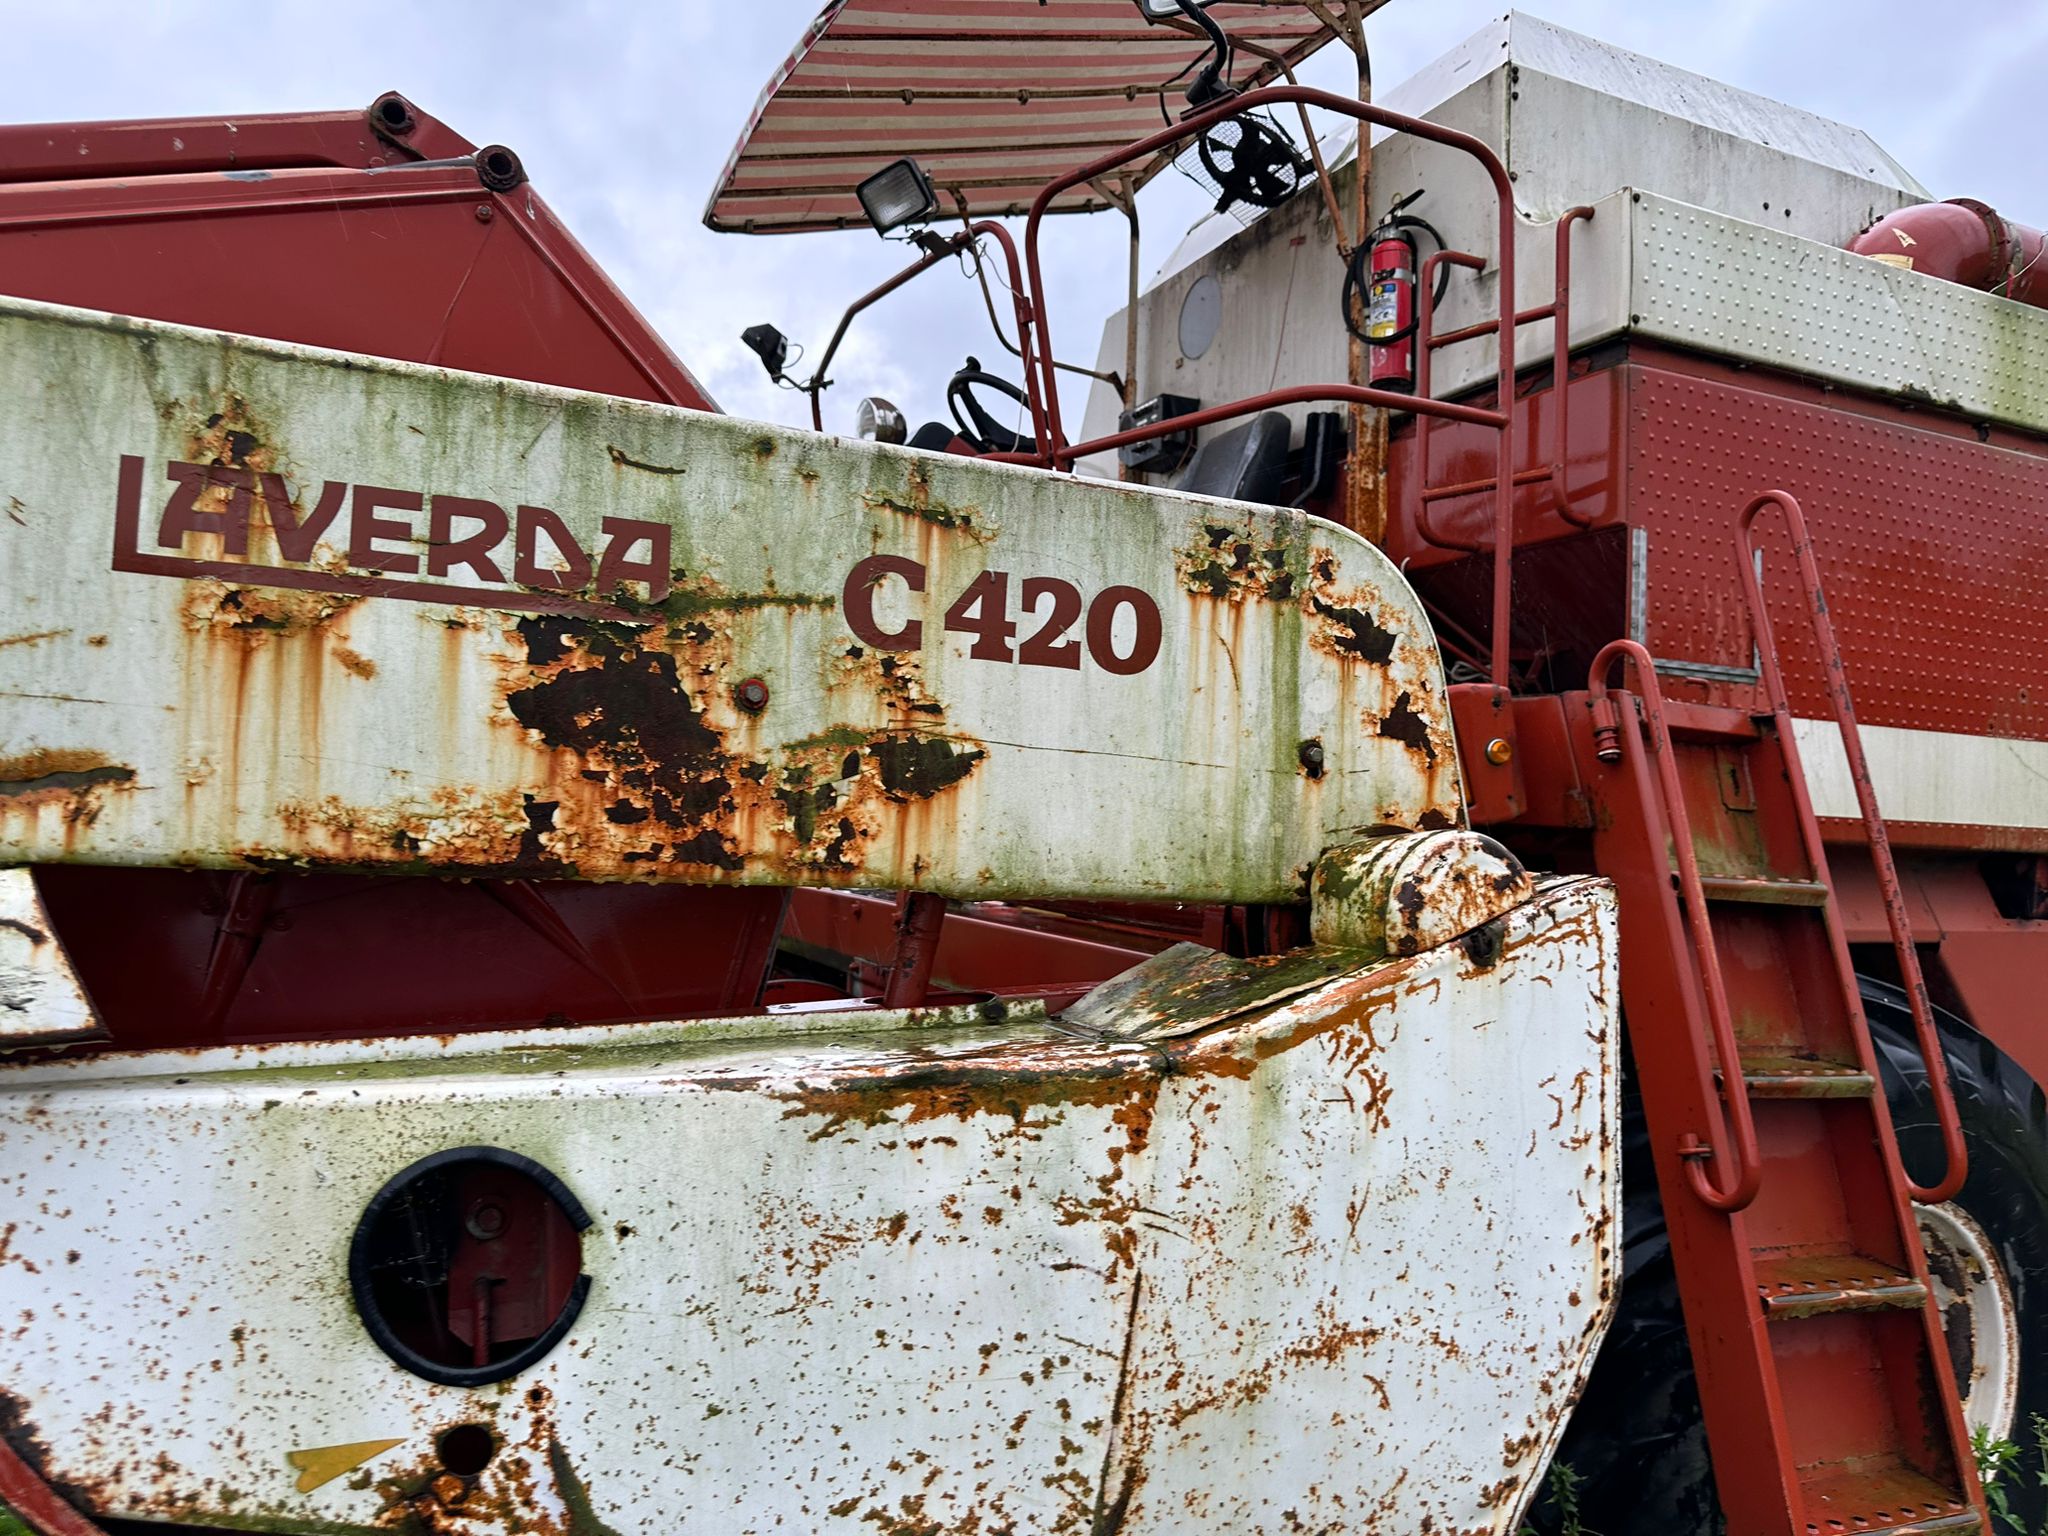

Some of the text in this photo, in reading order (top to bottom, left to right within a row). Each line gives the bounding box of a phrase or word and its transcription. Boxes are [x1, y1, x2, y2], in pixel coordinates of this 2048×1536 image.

[112, 454, 672, 624] LAVERDA
[842, 554, 1163, 675] C 420
